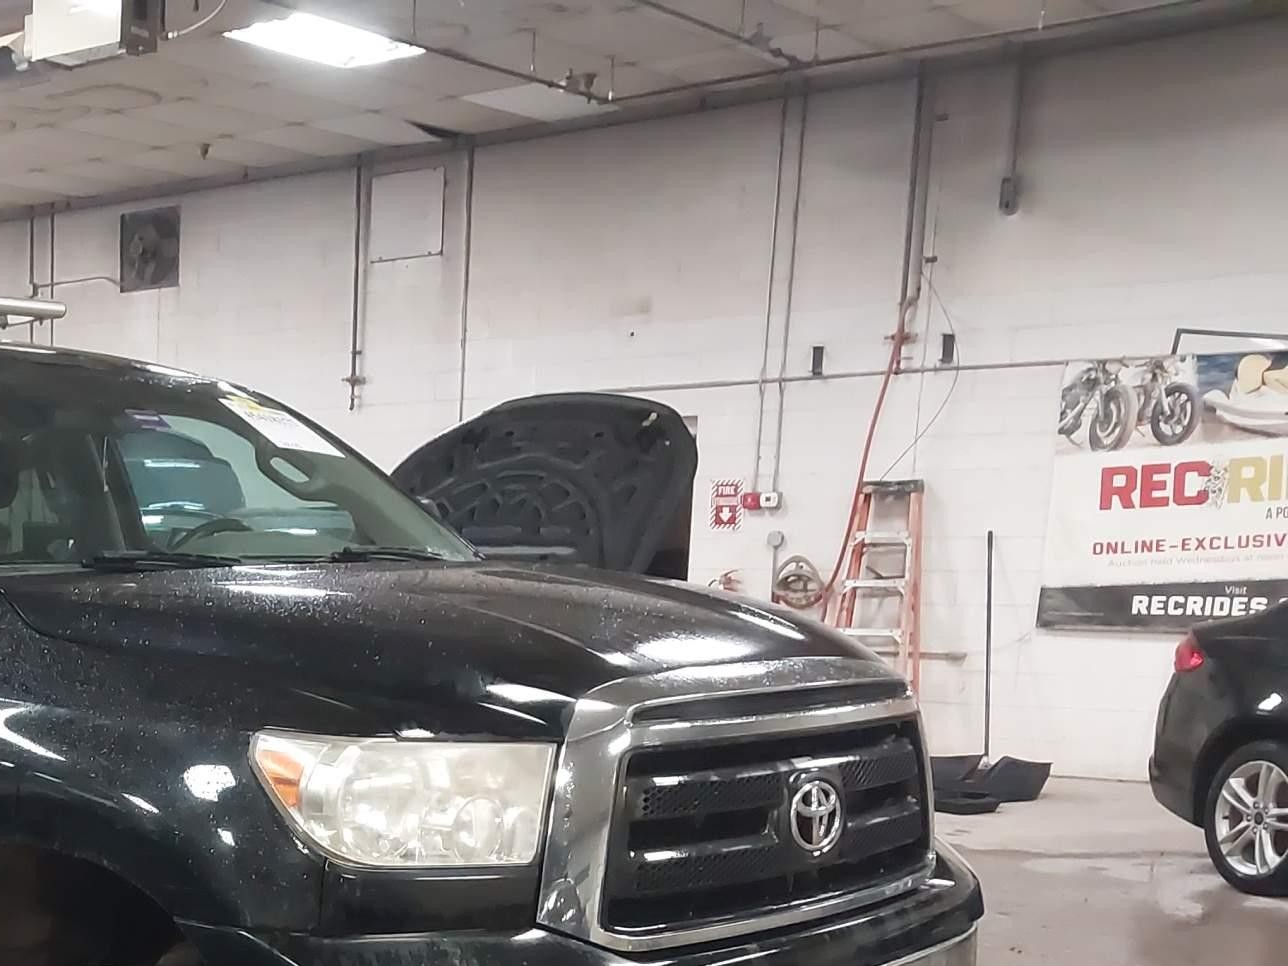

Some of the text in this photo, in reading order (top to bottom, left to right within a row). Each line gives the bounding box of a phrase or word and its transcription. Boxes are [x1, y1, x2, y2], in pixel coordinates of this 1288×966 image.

[718, 485, 736, 496] FIRE
[1099, 454, 1288, 510] REC RI
[1265, 506, 1273, 520] A
[1092, 533, 1287, 555] ONLINE-EXCLUSIV
[1224, 585, 1248, 595] Visit
[1130, 594, 1288, 617] RECRIDES
